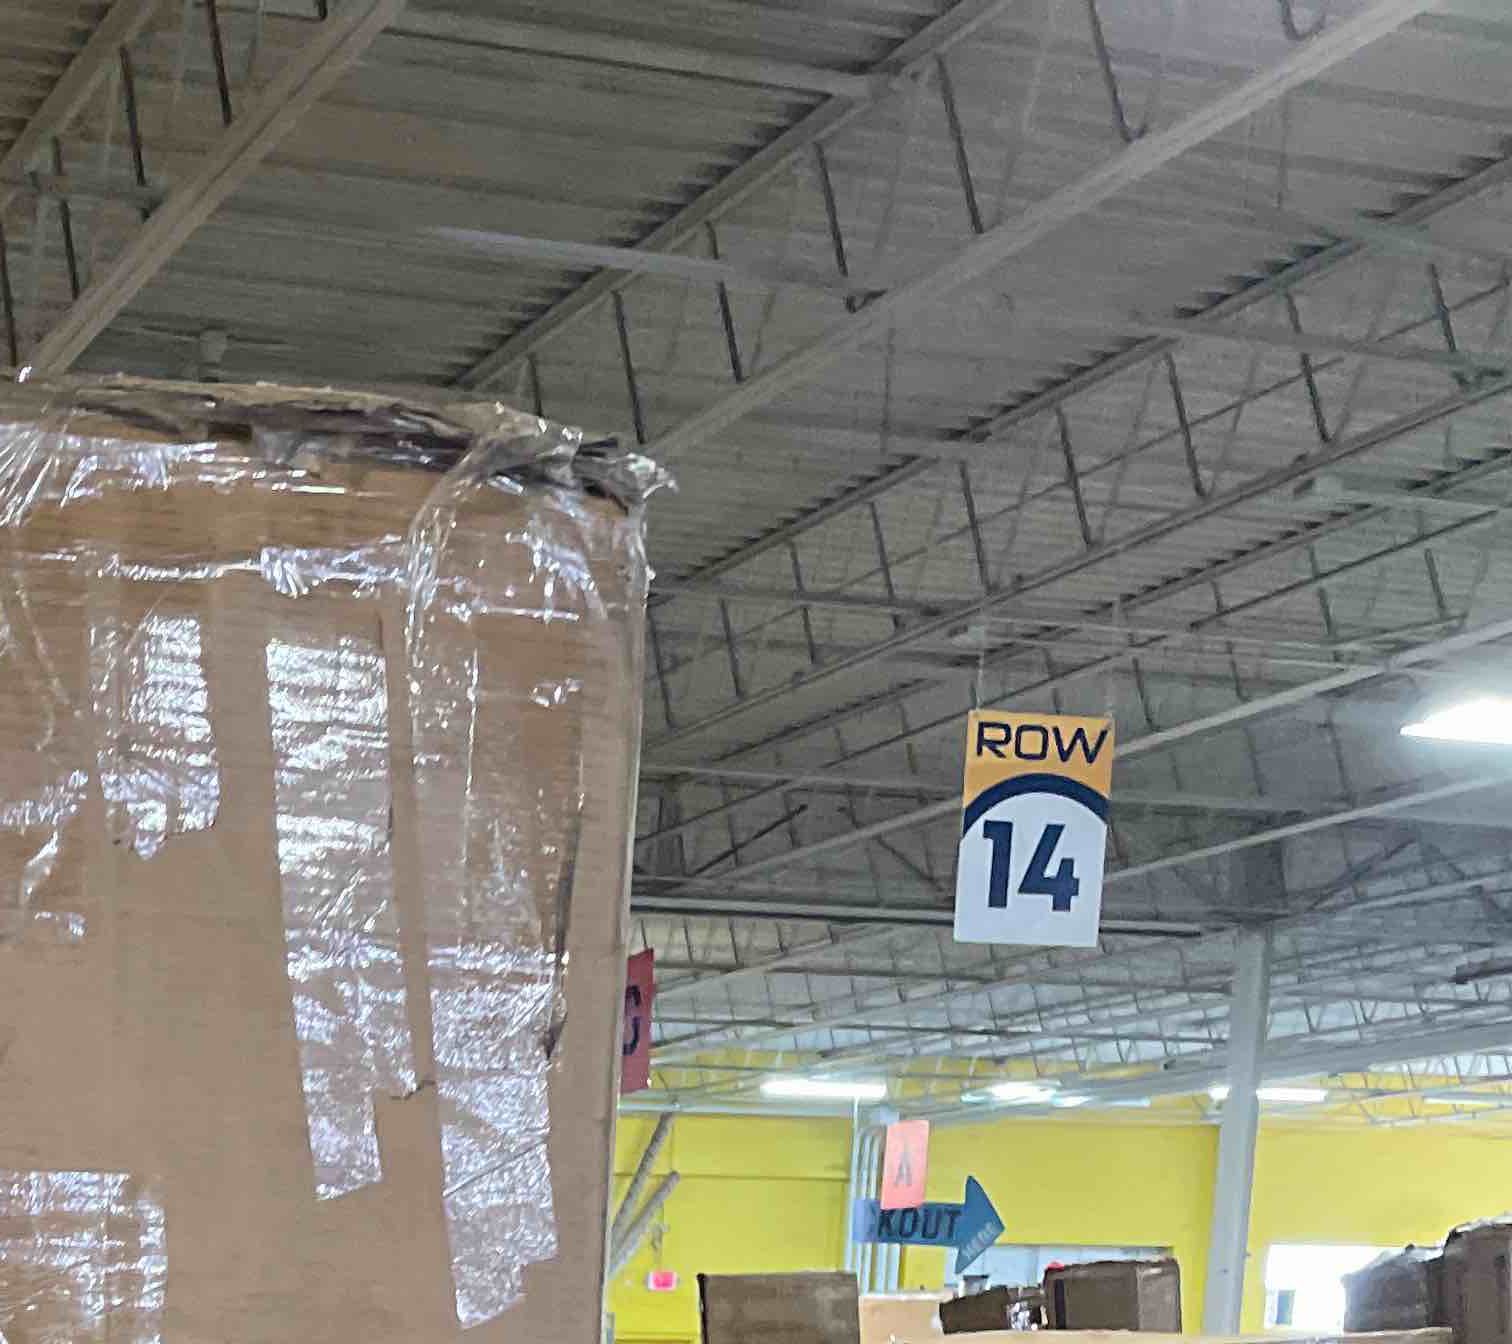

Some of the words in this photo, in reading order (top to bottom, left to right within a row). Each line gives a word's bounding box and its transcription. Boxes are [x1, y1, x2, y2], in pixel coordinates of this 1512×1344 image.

[975, 720, 1111, 767] ROW
[981, 820, 1081, 913] 14
[871, 1207, 962, 1239] KOUT
